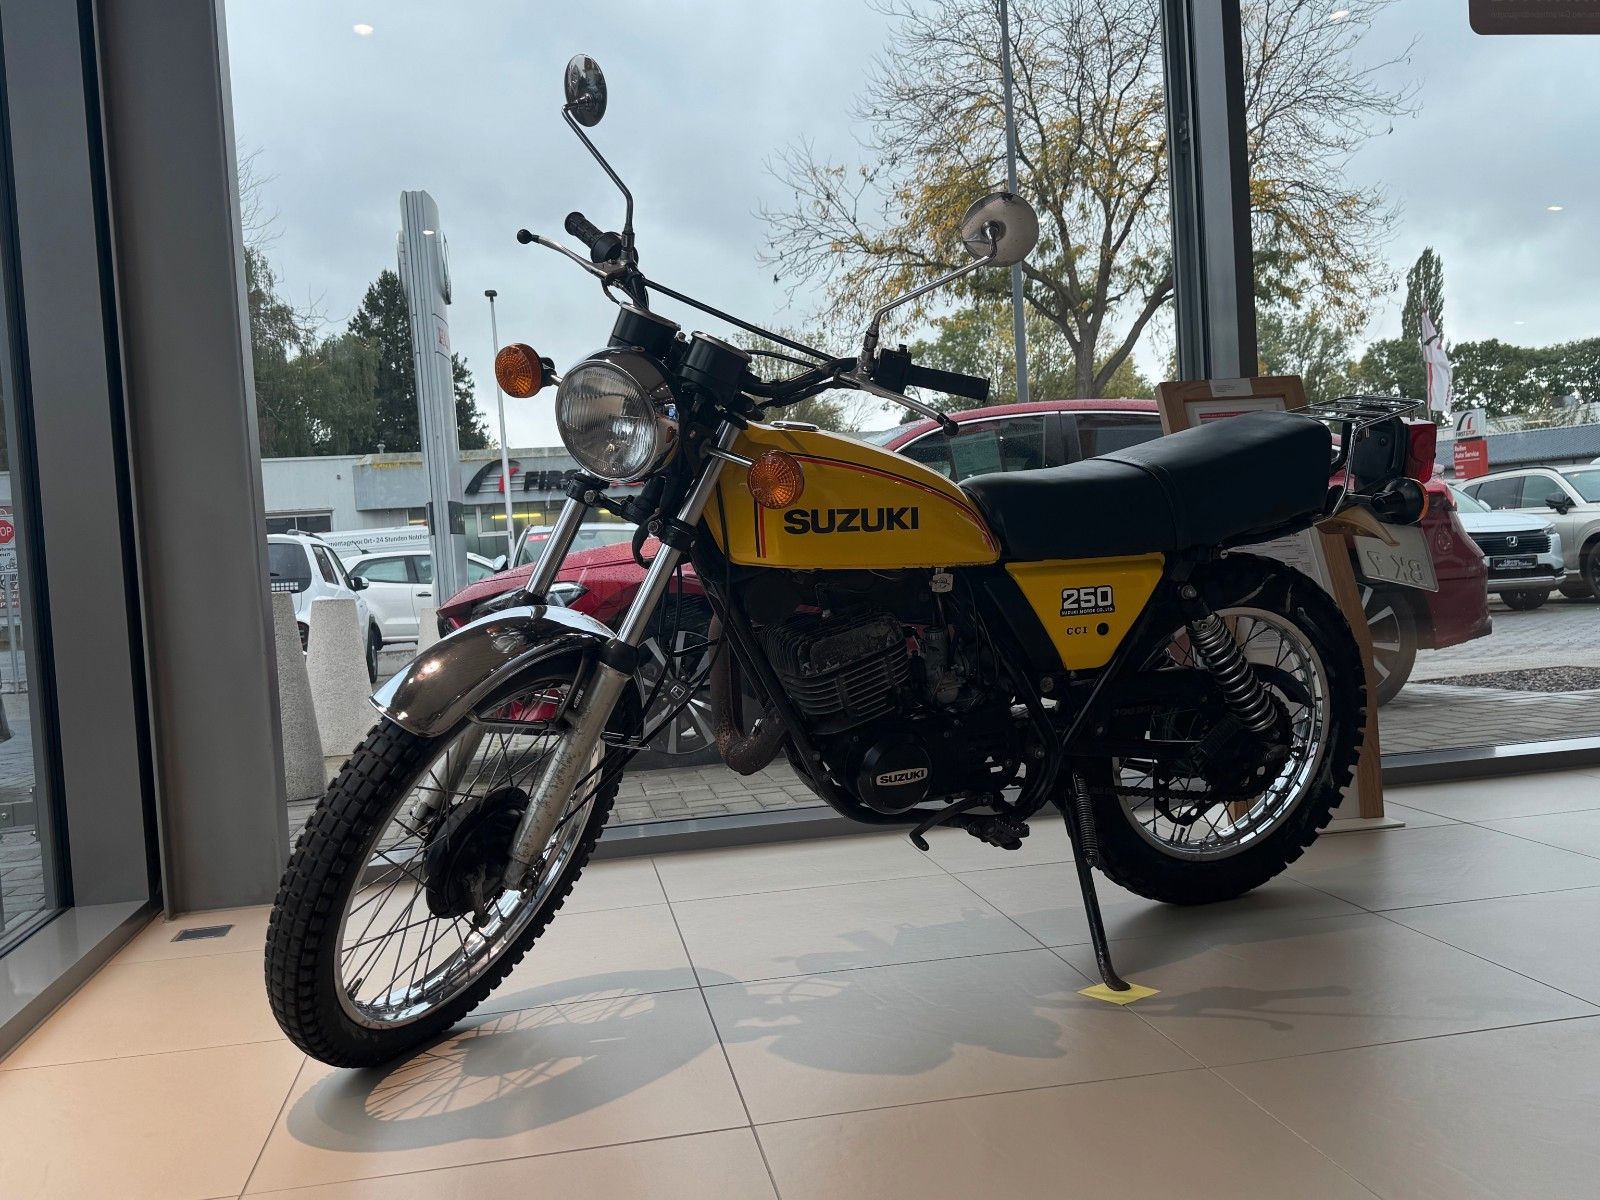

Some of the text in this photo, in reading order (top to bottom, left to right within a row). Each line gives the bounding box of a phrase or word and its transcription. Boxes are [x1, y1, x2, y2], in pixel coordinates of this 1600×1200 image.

[783, 506, 919, 535] SUZUKI
[1062, 586, 1112, 610] 250
[1066, 626, 1088, 636] CCI
[880, 769, 925, 784] SUZUKI
